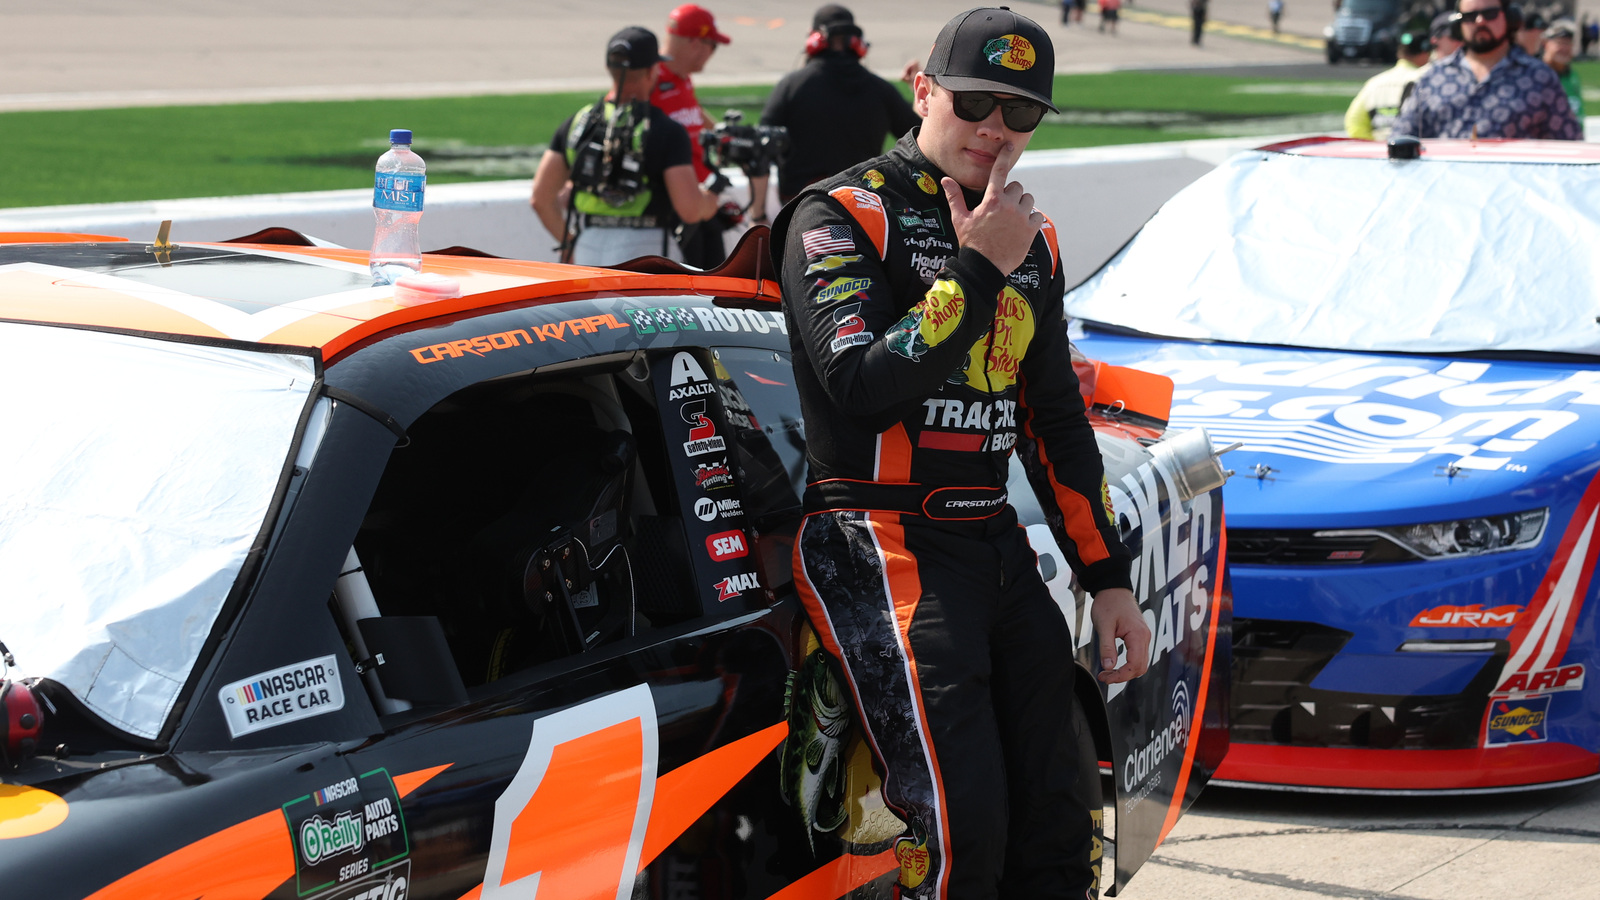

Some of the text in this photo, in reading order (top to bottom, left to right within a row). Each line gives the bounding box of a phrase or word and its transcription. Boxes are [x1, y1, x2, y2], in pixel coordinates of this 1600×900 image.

[1010, 45, 1026, 58] Pro
[1011, 35, 1031, 50] Bass
[1008, 55, 1033, 69] Shops
[381, 189, 417, 203] MIST
[819, 279, 870, 301] SUNOCO
[931, 293, 966, 333] Shops
[409, 313, 631, 365] CARSON KVAPIL
[833, 334, 872, 350] safety-kleen
[669, 383, 717, 401] AXALTA
[687, 438, 725, 454] safety-kleen
[701, 474, 728, 489] Tinting
[716, 499, 741, 512] Miller
[720, 509, 744, 519] Welders
[945, 500, 991, 509] CARSON
[713, 535, 744, 556] SEM
[1418, 612, 1516, 628] JRM
[259, 664, 328, 699] NASCAR
[1495, 665, 1584, 692] ARP
[246, 689, 332, 724] RACE CAR
[1492, 712, 1543, 728] SUNOCO
[1124, 713, 1184, 793] Clarience
[323, 777, 360, 803] NASCAR
[480, 682, 659, 900] 1
[1125, 771, 1162, 816] TECHNOLOGIES
[365, 797, 392, 822] AUTO
[303, 817, 362, 860] O'Reilly
[365, 814, 399, 842] PARTS
[339, 858, 369, 882] SERIES
[914, 849, 928, 877] Bass
